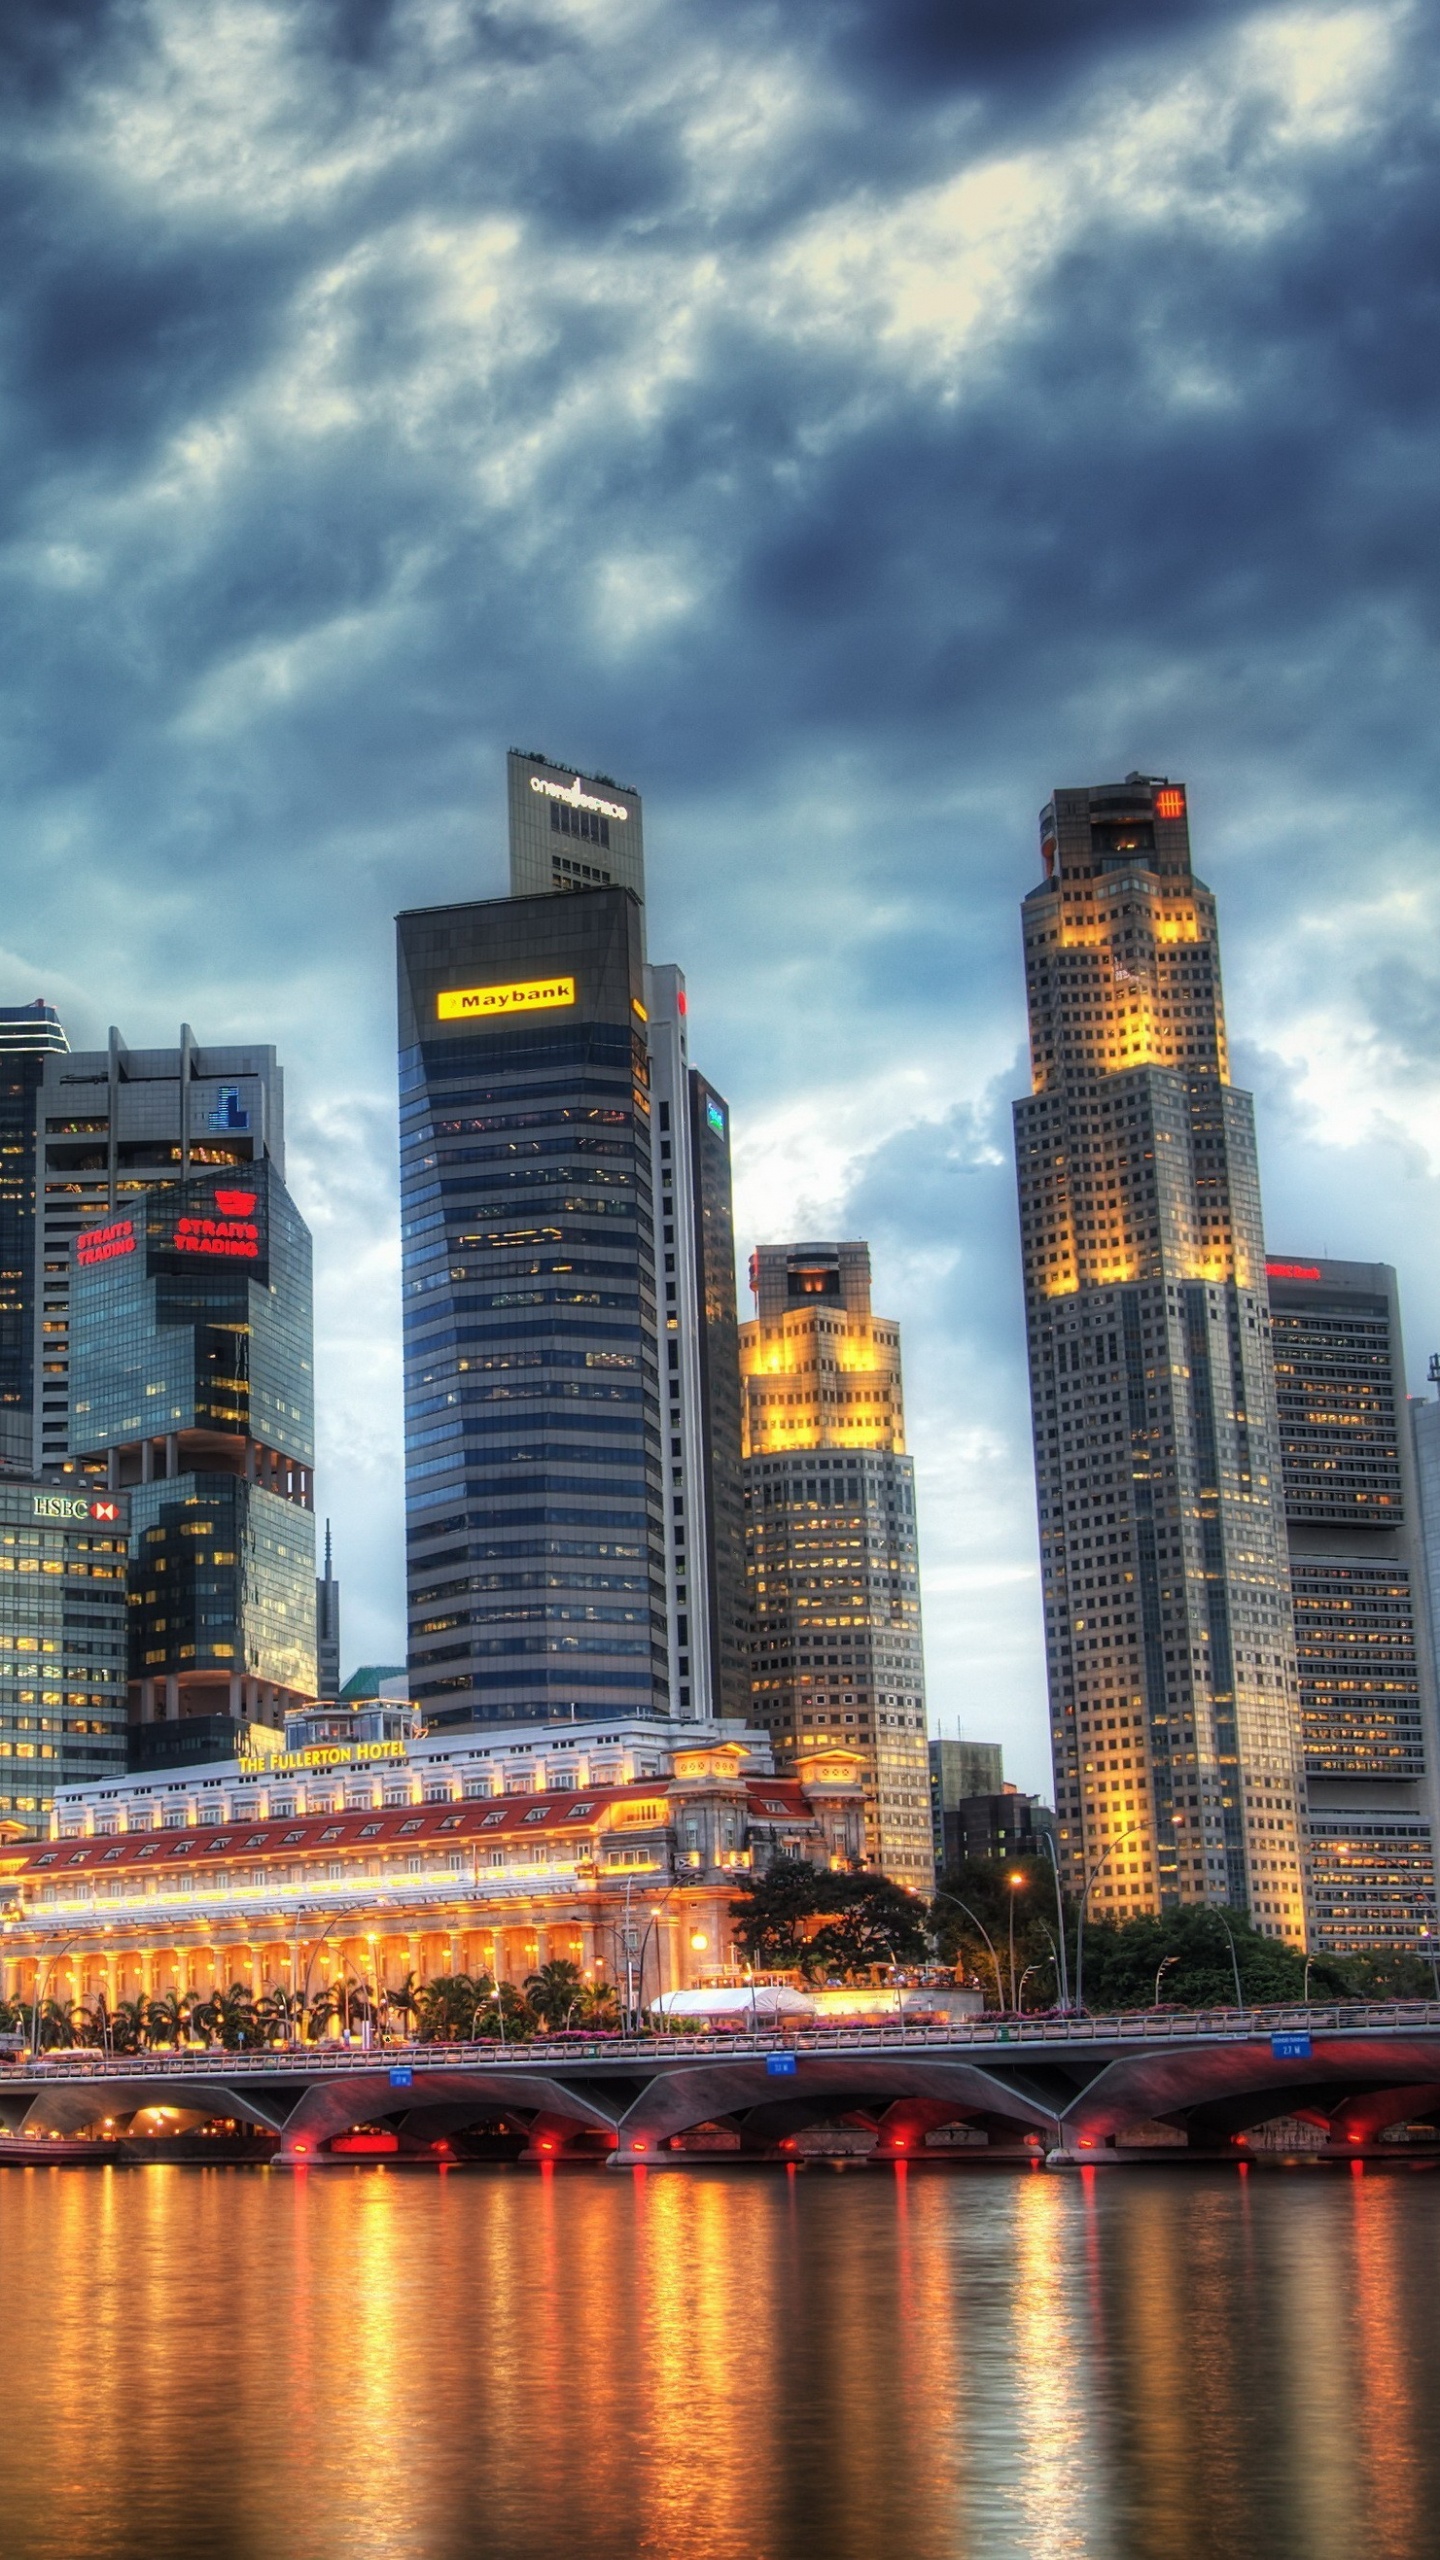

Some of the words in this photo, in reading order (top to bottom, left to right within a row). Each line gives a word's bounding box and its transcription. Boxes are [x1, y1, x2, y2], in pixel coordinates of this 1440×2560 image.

[461, 985, 570, 1008] Maybank
[77, 1221, 133, 1248] STRAITS
[179, 1218, 257, 1238] STRAITS
[77, 1237, 137, 1265] TRADING
[174, 1234, 258, 1256] TRADING
[34, 1497, 89, 1519] HSBC
[238, 1757, 266, 1773] THE
[271, 1748, 351, 1769] FULLERTON
[357, 1741, 406, 1759] HOTEL
